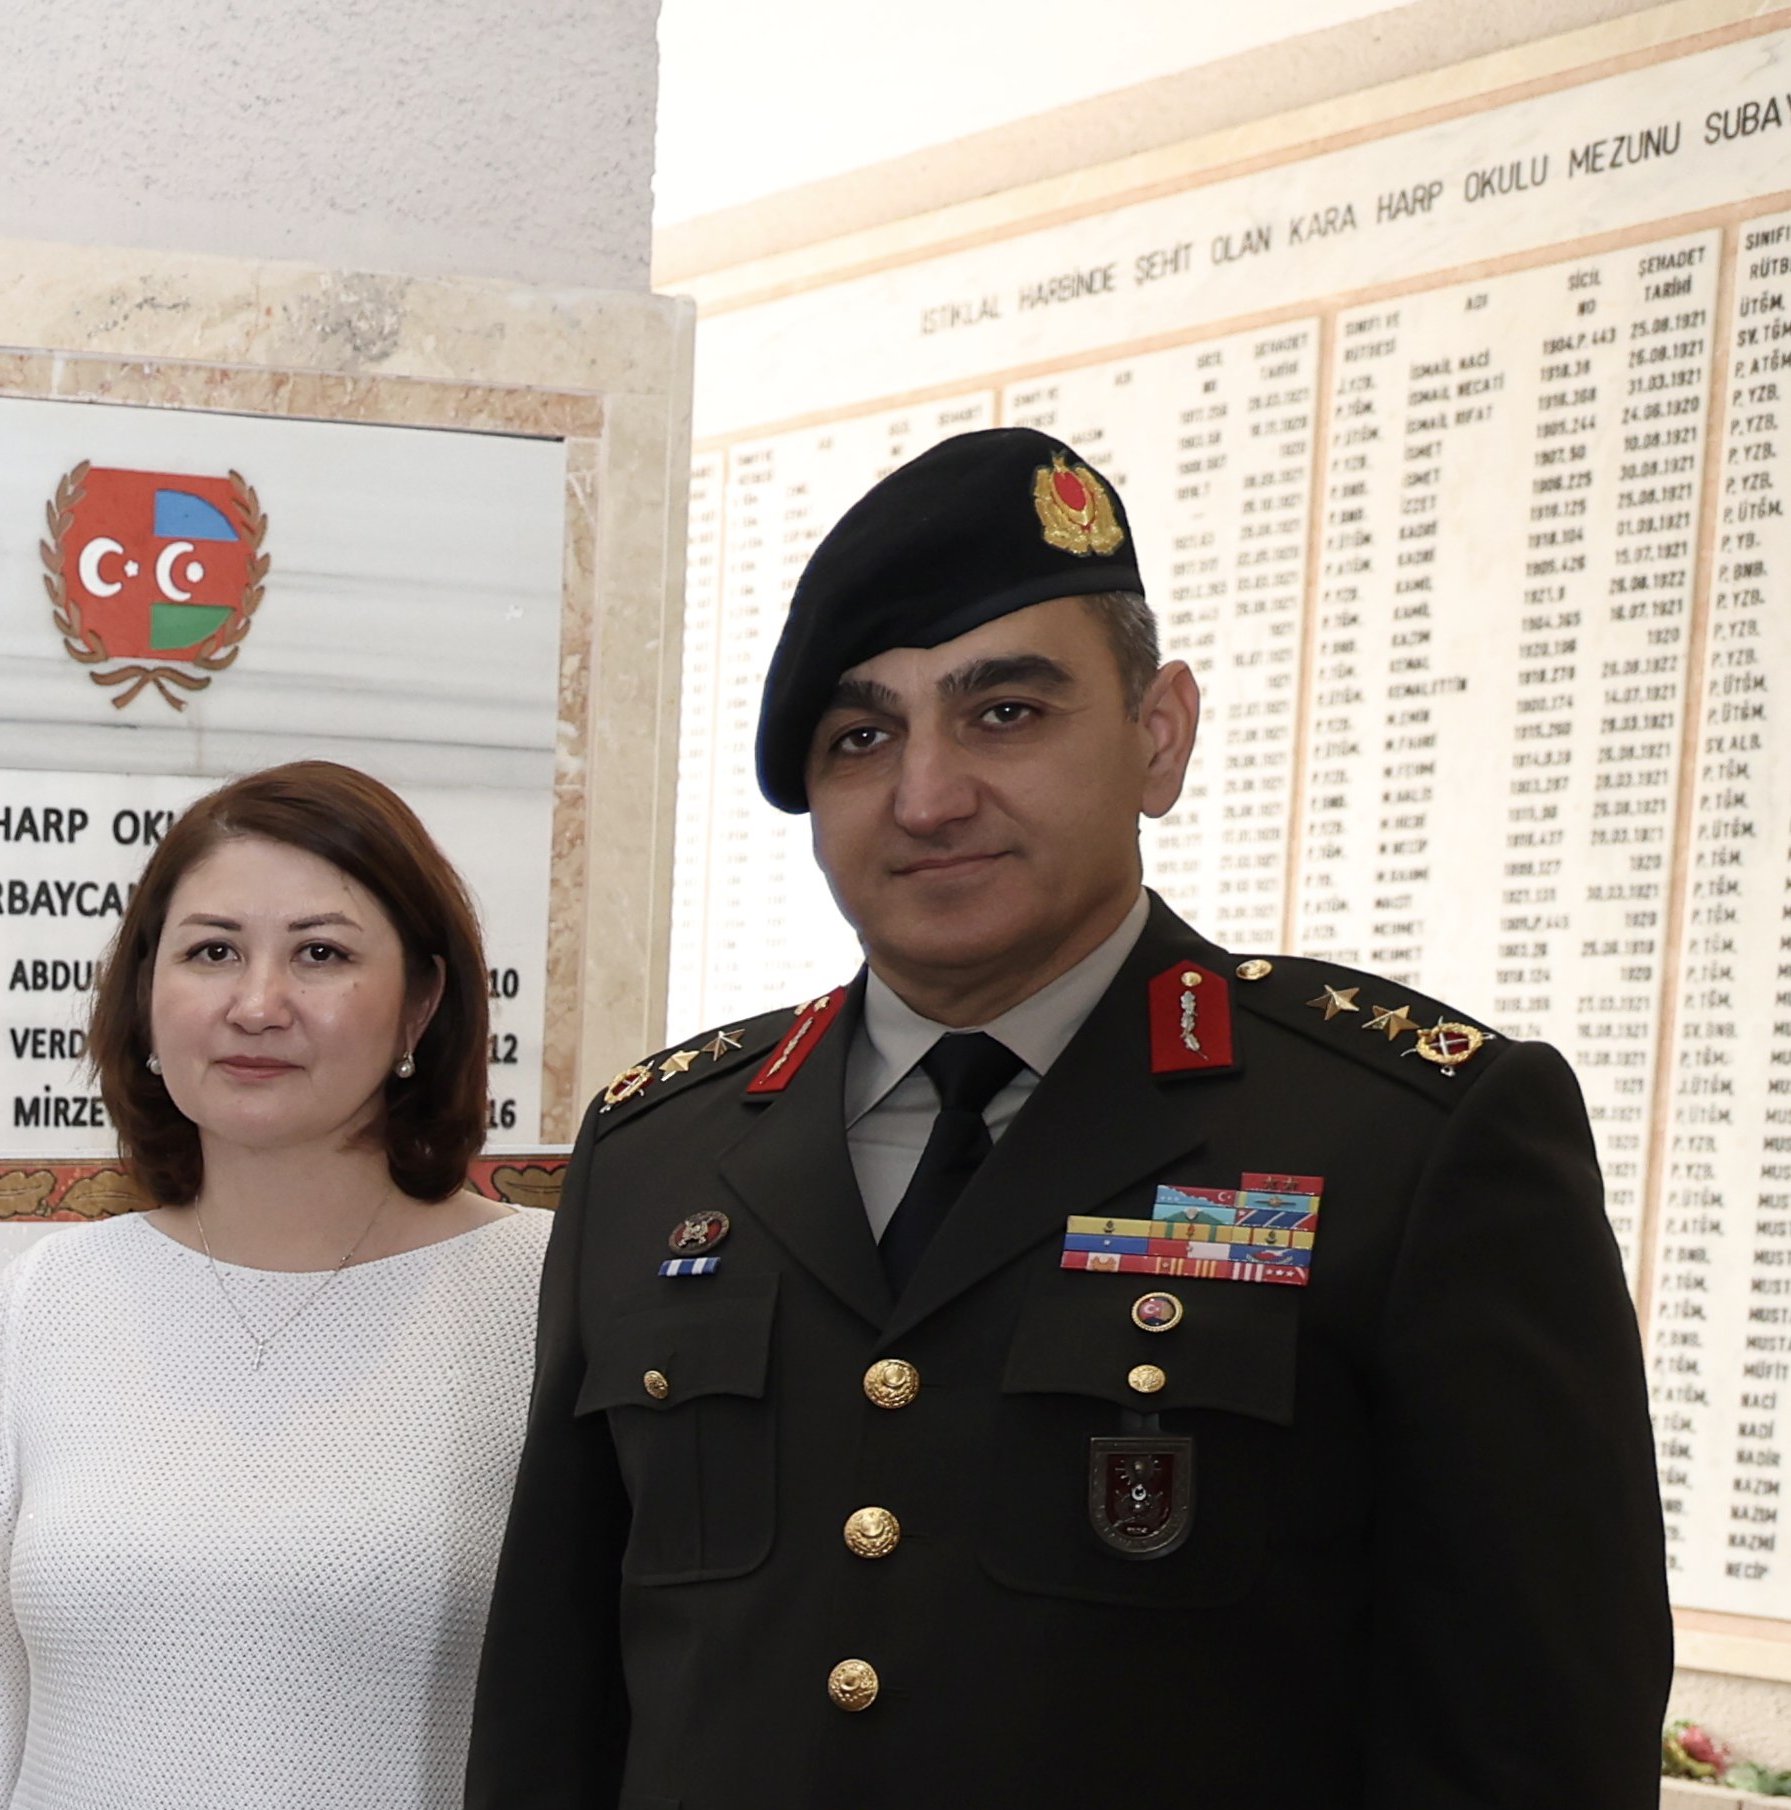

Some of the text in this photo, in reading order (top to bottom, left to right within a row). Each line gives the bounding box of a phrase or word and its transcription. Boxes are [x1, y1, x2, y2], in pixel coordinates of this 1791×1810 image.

[1020, 264, 1114, 308] HARBİNDE
[1135, 243, 1192, 286] ŞEHİT
[1212, 226, 1272, 265] OLAN
[1288, 202, 1358, 247] KARA
[1377, 181, 1443, 223] HARP
[1465, 155, 1549, 203] OKULU
[1569, 122, 1680, 178] MEZUNU
[1639, 246, 1705, 280] ŞEHADET
[1750, 257, 1791, 278] RÜTB
[1568, 270, 1601, 291] SİCİL
[1646, 275, 1692, 300] TARİHİ
[1740, 292, 1785, 317] ÜTĞM.
[112, 809, 179, 846] OK
[9, 957, 102, 992] ABDU
[489, 968, 519, 999] 10
[489, 1032, 518, 1065] 12
[14, 1088, 111, 1128] MİRZE
[487, 1098, 517, 1130] 16
[1758, 1195, 1791, 1209] MUS
[1749, 1308, 1791, 1322] MUST
